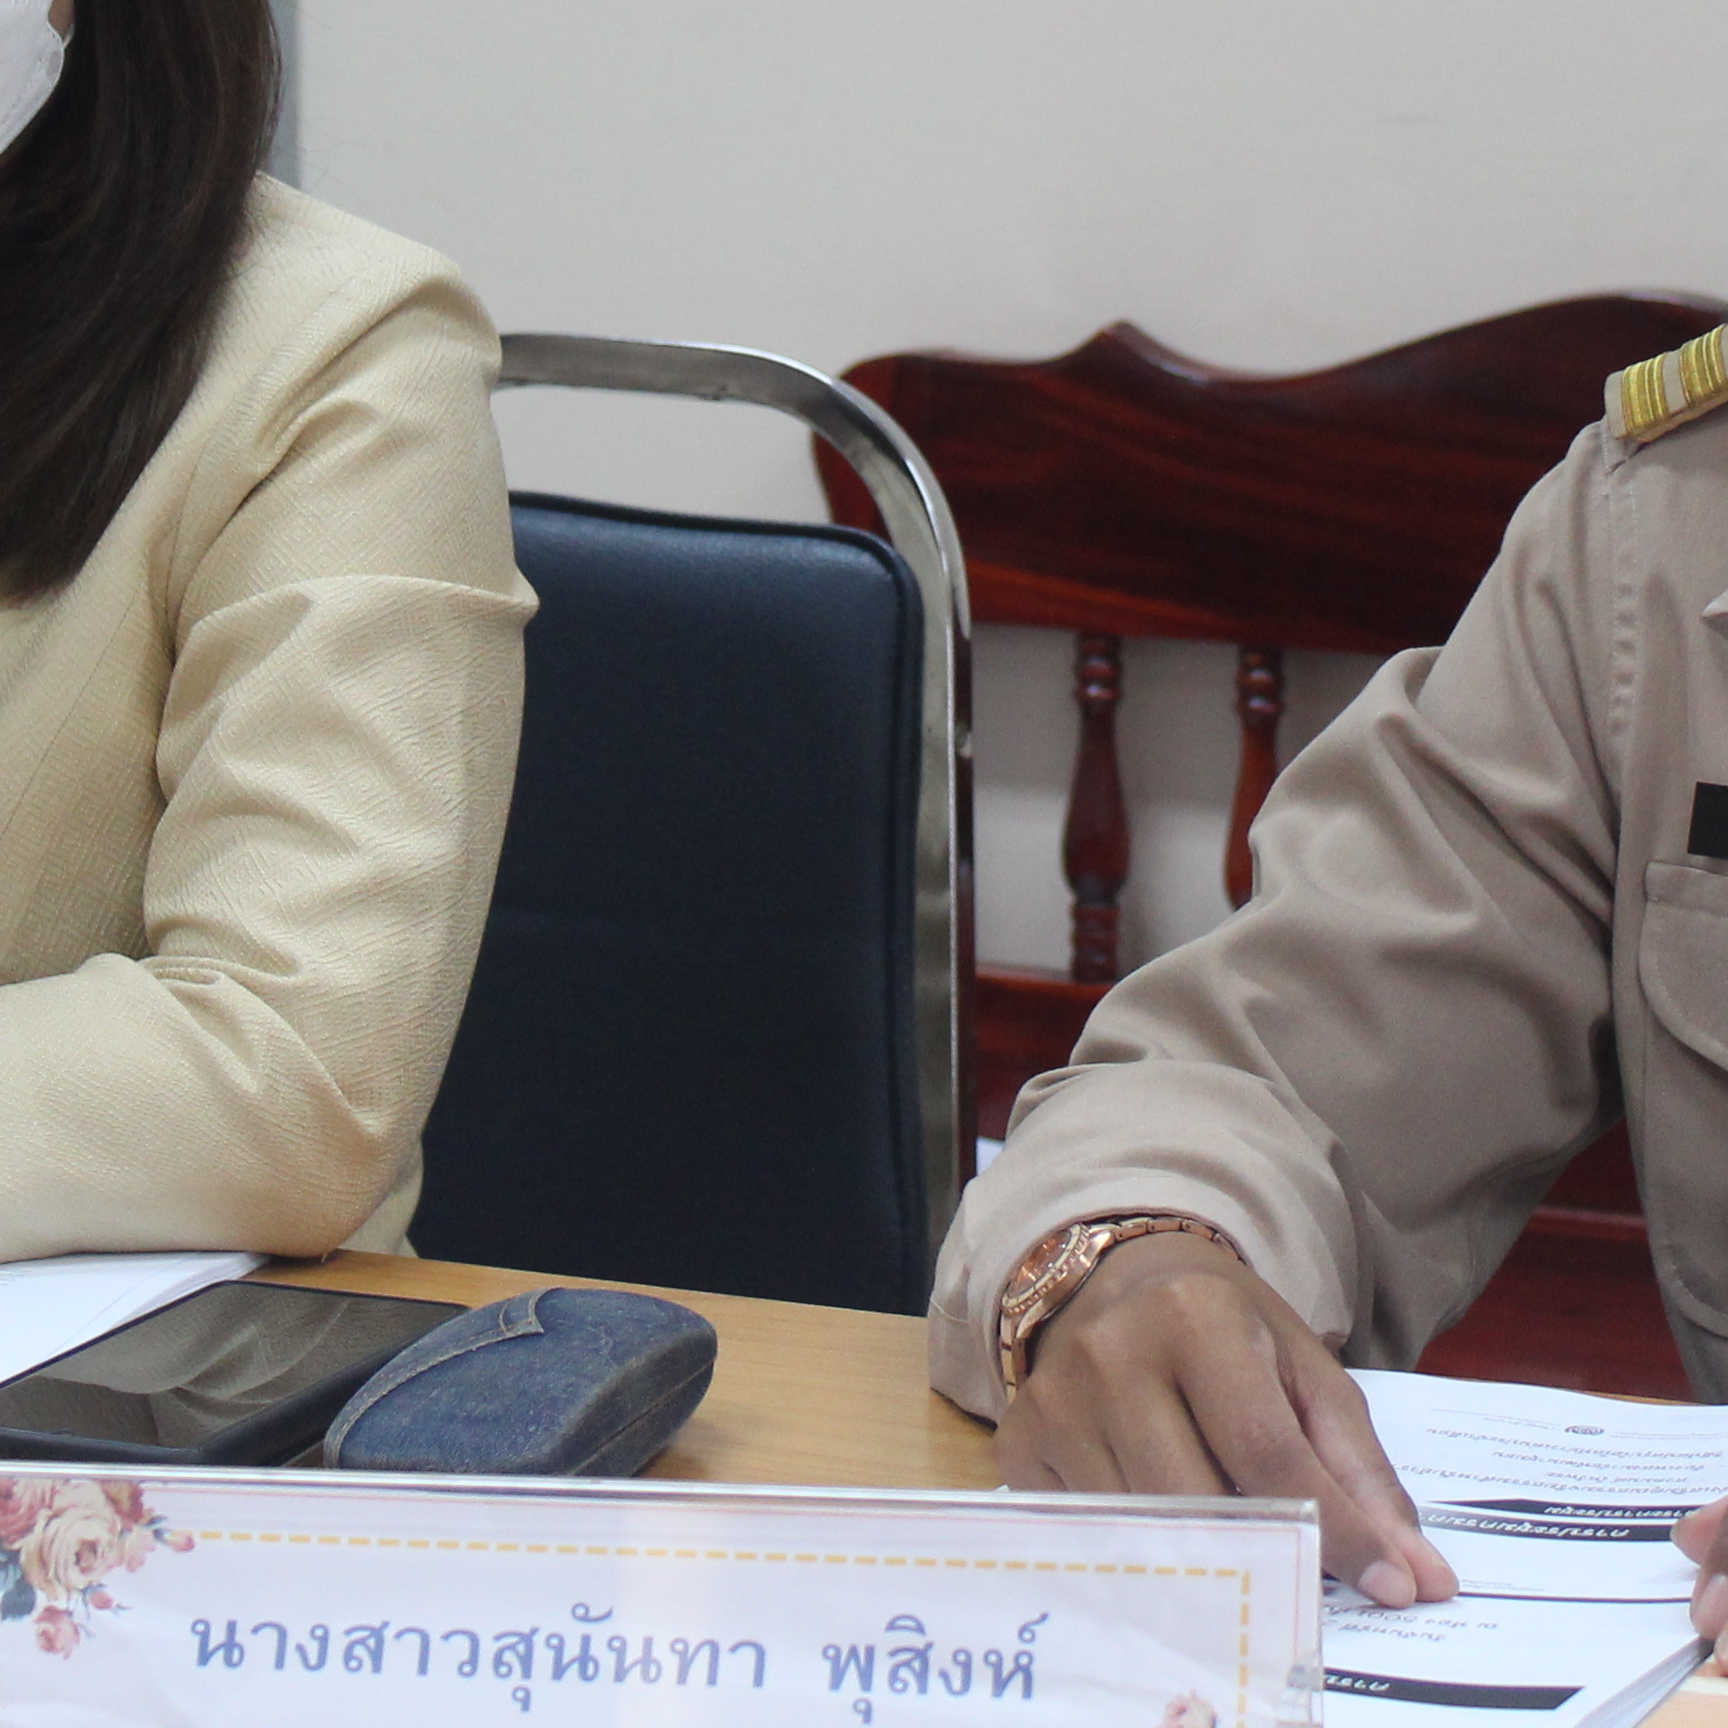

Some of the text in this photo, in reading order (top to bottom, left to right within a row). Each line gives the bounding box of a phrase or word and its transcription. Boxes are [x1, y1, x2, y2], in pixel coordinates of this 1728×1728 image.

[190, 1602, 1049, 1725] นางสาวสุนันทา พุสิงห์
